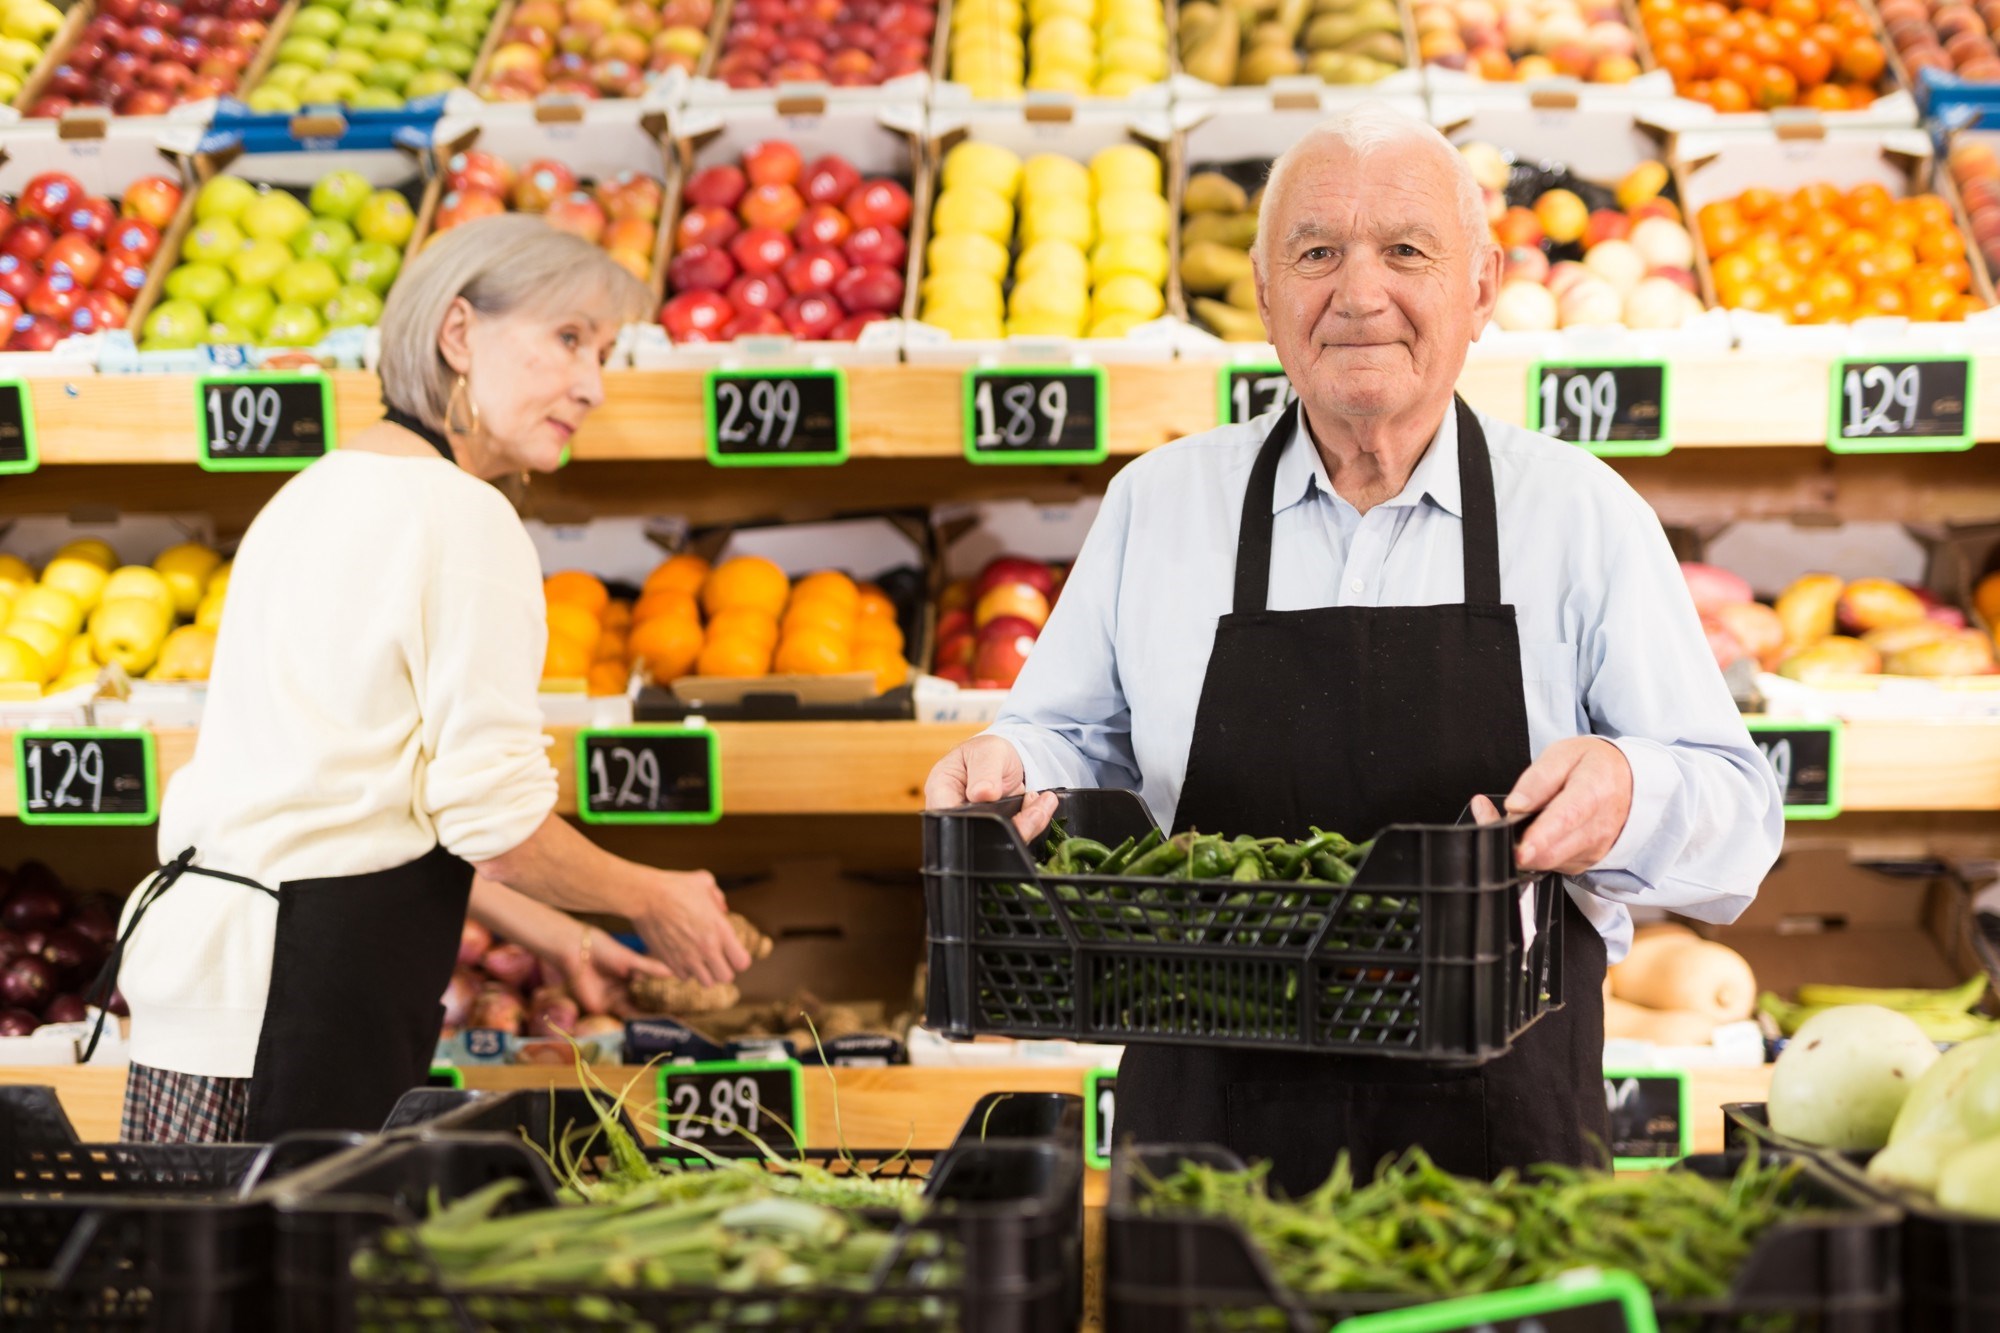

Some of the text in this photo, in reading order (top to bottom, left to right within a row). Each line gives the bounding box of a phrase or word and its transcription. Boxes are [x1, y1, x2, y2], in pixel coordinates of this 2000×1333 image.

[207, 386, 281, 453] 1.99
[717, 380, 800, 448] 2.99
[976, 380, 1068, 446] 1.89
[1232, 375, 1298, 423] 17
[1540, 371, 1617, 443] 1.99
[1843, 365, 1919, 437] 1.29
[27, 741, 104, 812] 1.29
